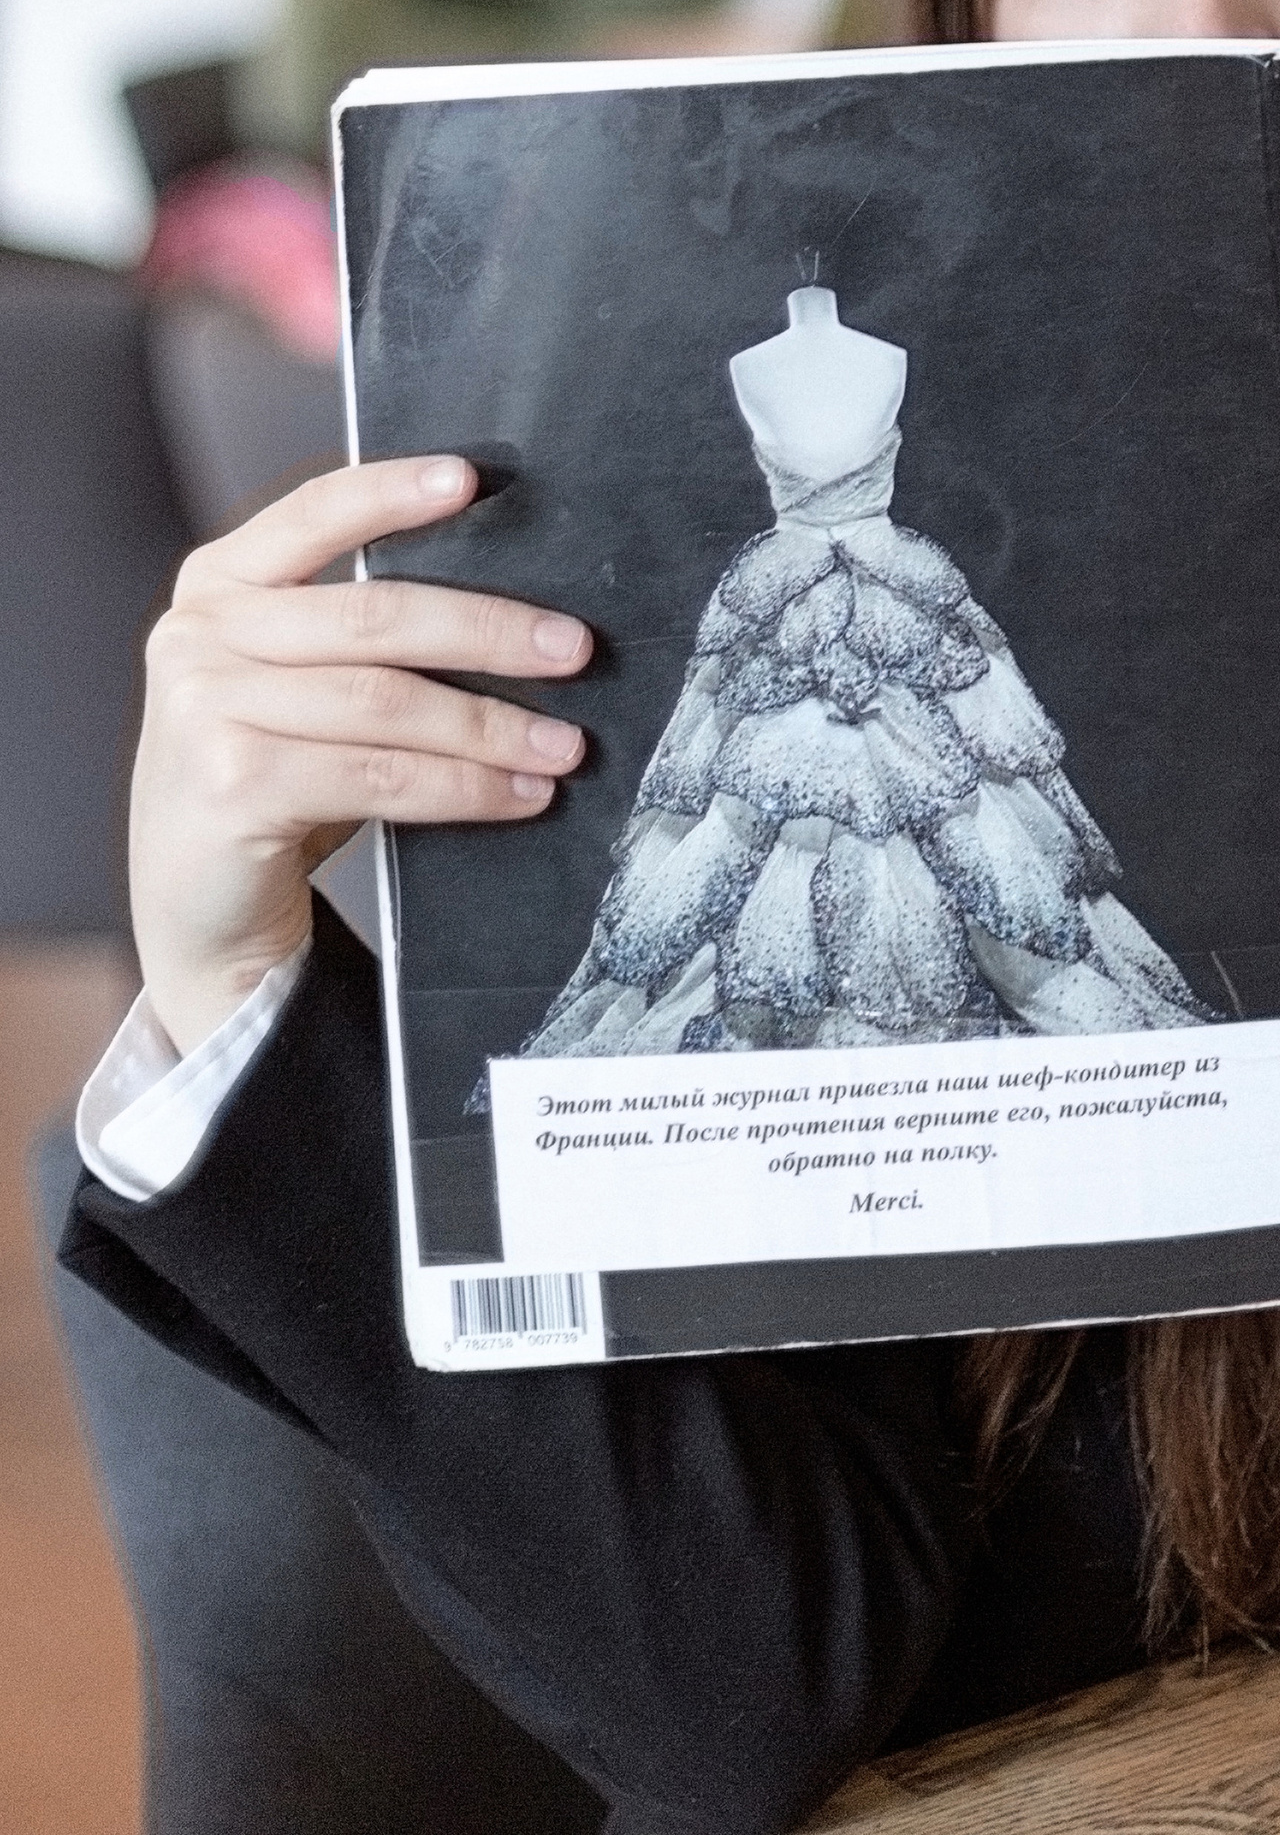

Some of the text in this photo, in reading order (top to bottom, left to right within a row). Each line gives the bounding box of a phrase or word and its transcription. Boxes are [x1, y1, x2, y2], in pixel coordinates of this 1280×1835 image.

[537, 1055, 1220, 1117] Этот милый журнал привезла наш шеф-кондитер из
[535, 1089, 1228, 1156] Франции. После прочтения верните его, пожалуйста,
[768, 1142, 998, 1176] обратно на полку.
[849, 1189, 924, 1214] Merci.
